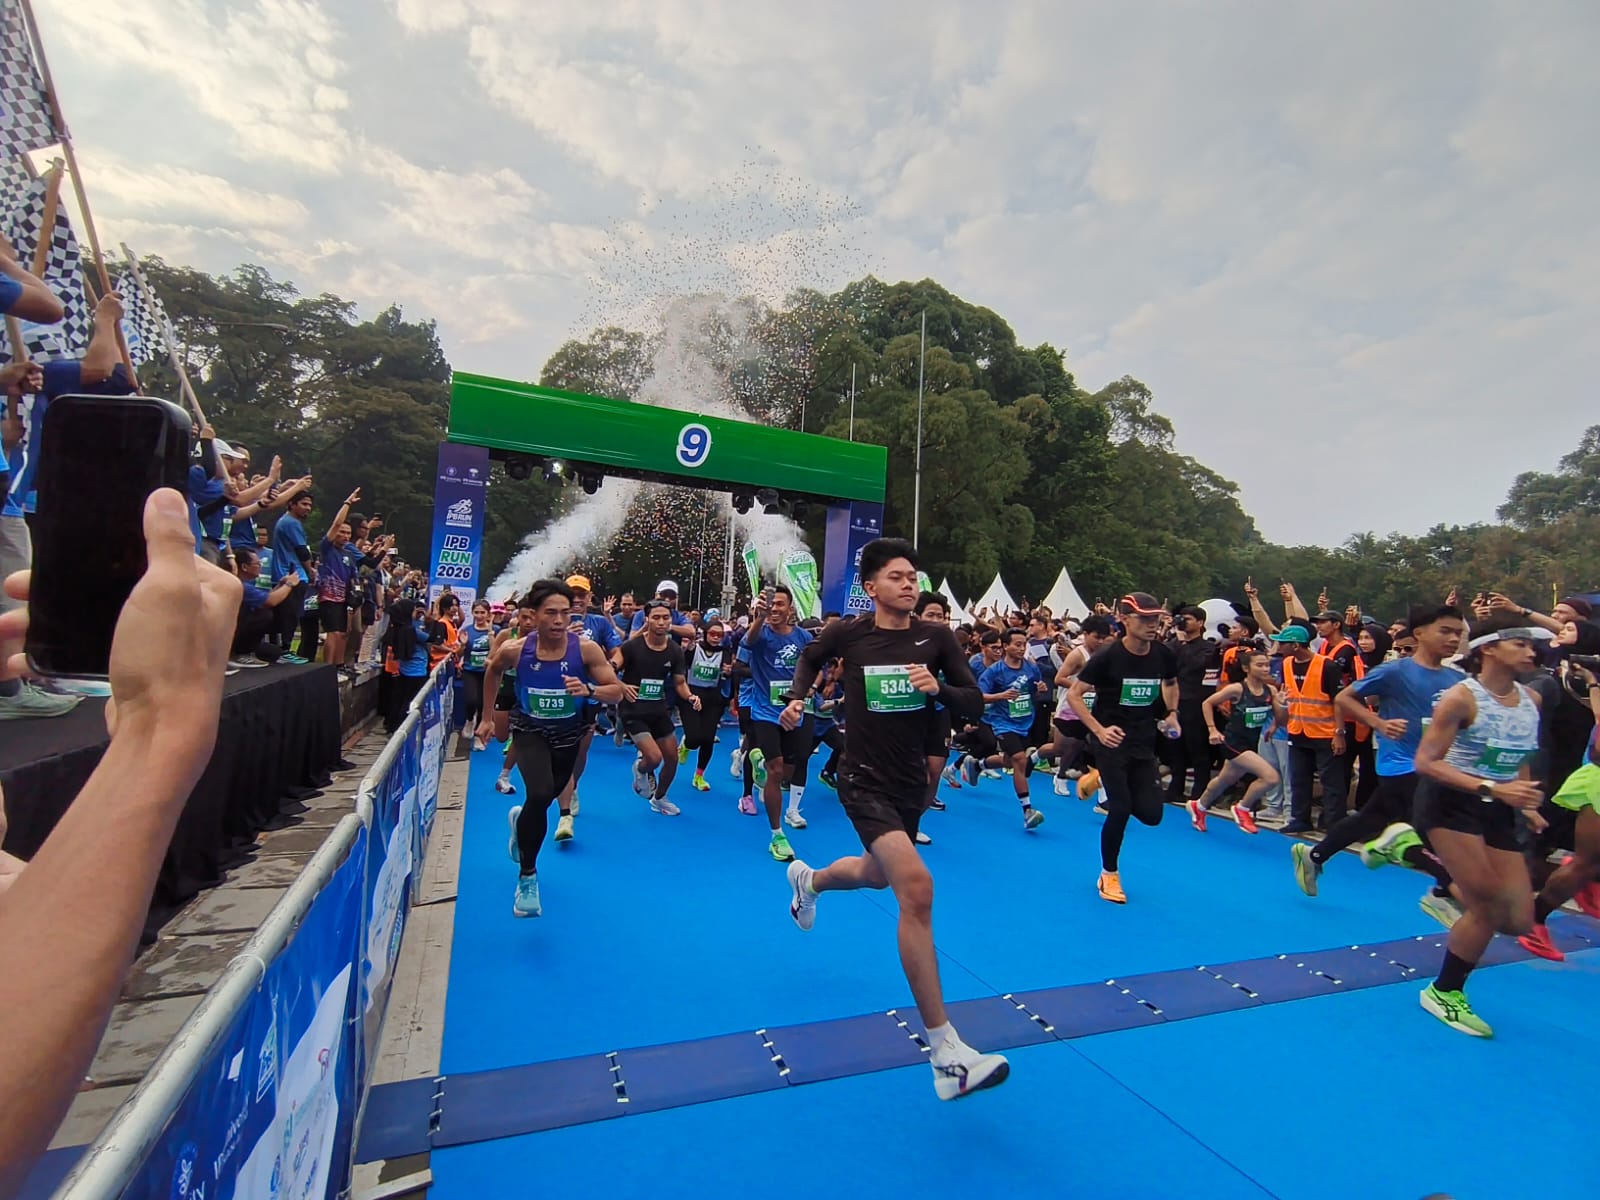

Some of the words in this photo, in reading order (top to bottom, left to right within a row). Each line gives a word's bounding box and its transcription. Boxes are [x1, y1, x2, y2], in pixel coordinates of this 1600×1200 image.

[677, 424, 711, 466] 9
[444, 535, 469, 550] IPB
[439, 549, 472, 564] RUN
[436, 565, 472, 579] 2026
[848, 598, 872, 610] 2026
[880, 679, 914, 694] 5343
[1130, 687, 1152, 696] 6374
[538, 697, 565, 708] 6739
